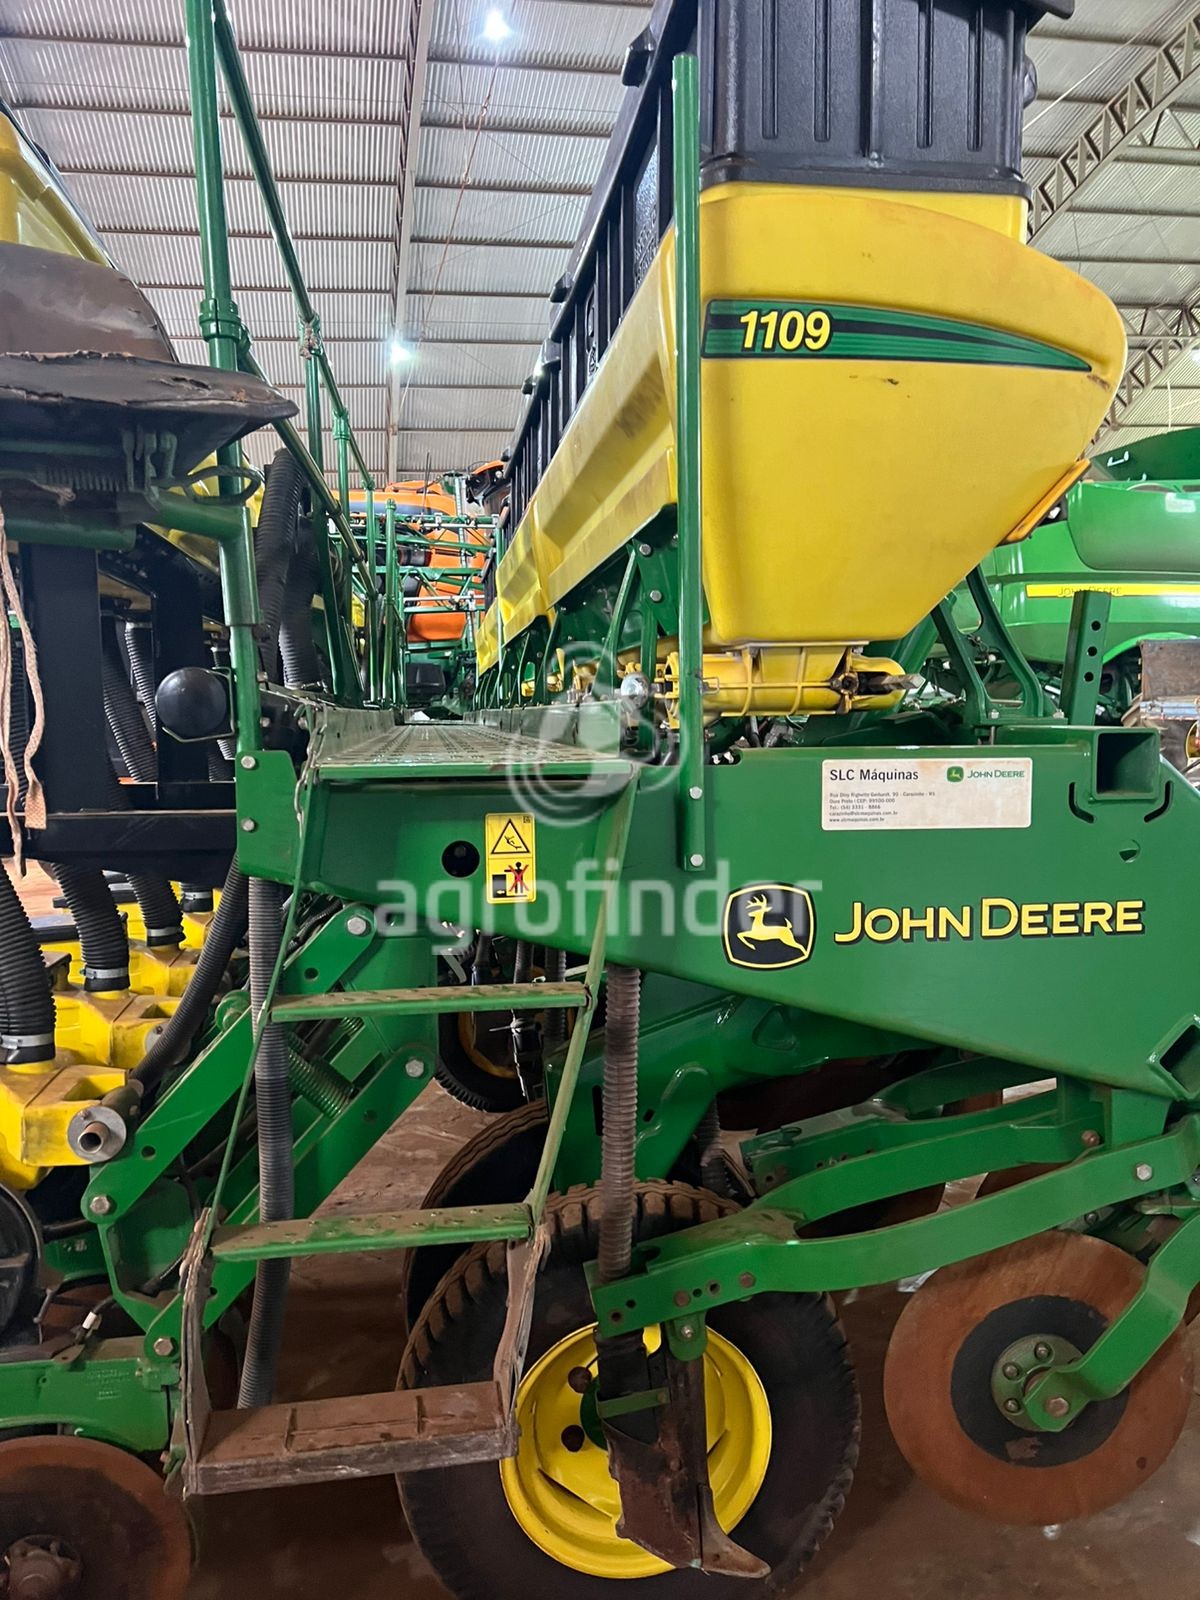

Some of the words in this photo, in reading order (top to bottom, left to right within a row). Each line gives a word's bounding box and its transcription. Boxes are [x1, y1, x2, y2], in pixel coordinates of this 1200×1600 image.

[740, 310, 831, 350] 1109
[829, 769, 855, 781] SLC
[859, 768, 919, 783] Máquinas
[967, 770, 992, 779] JOHN
[994, 769, 1024, 778] DEERE
[834, 901, 971, 943] JOHN
[981, 898, 1144, 937] DEERE
